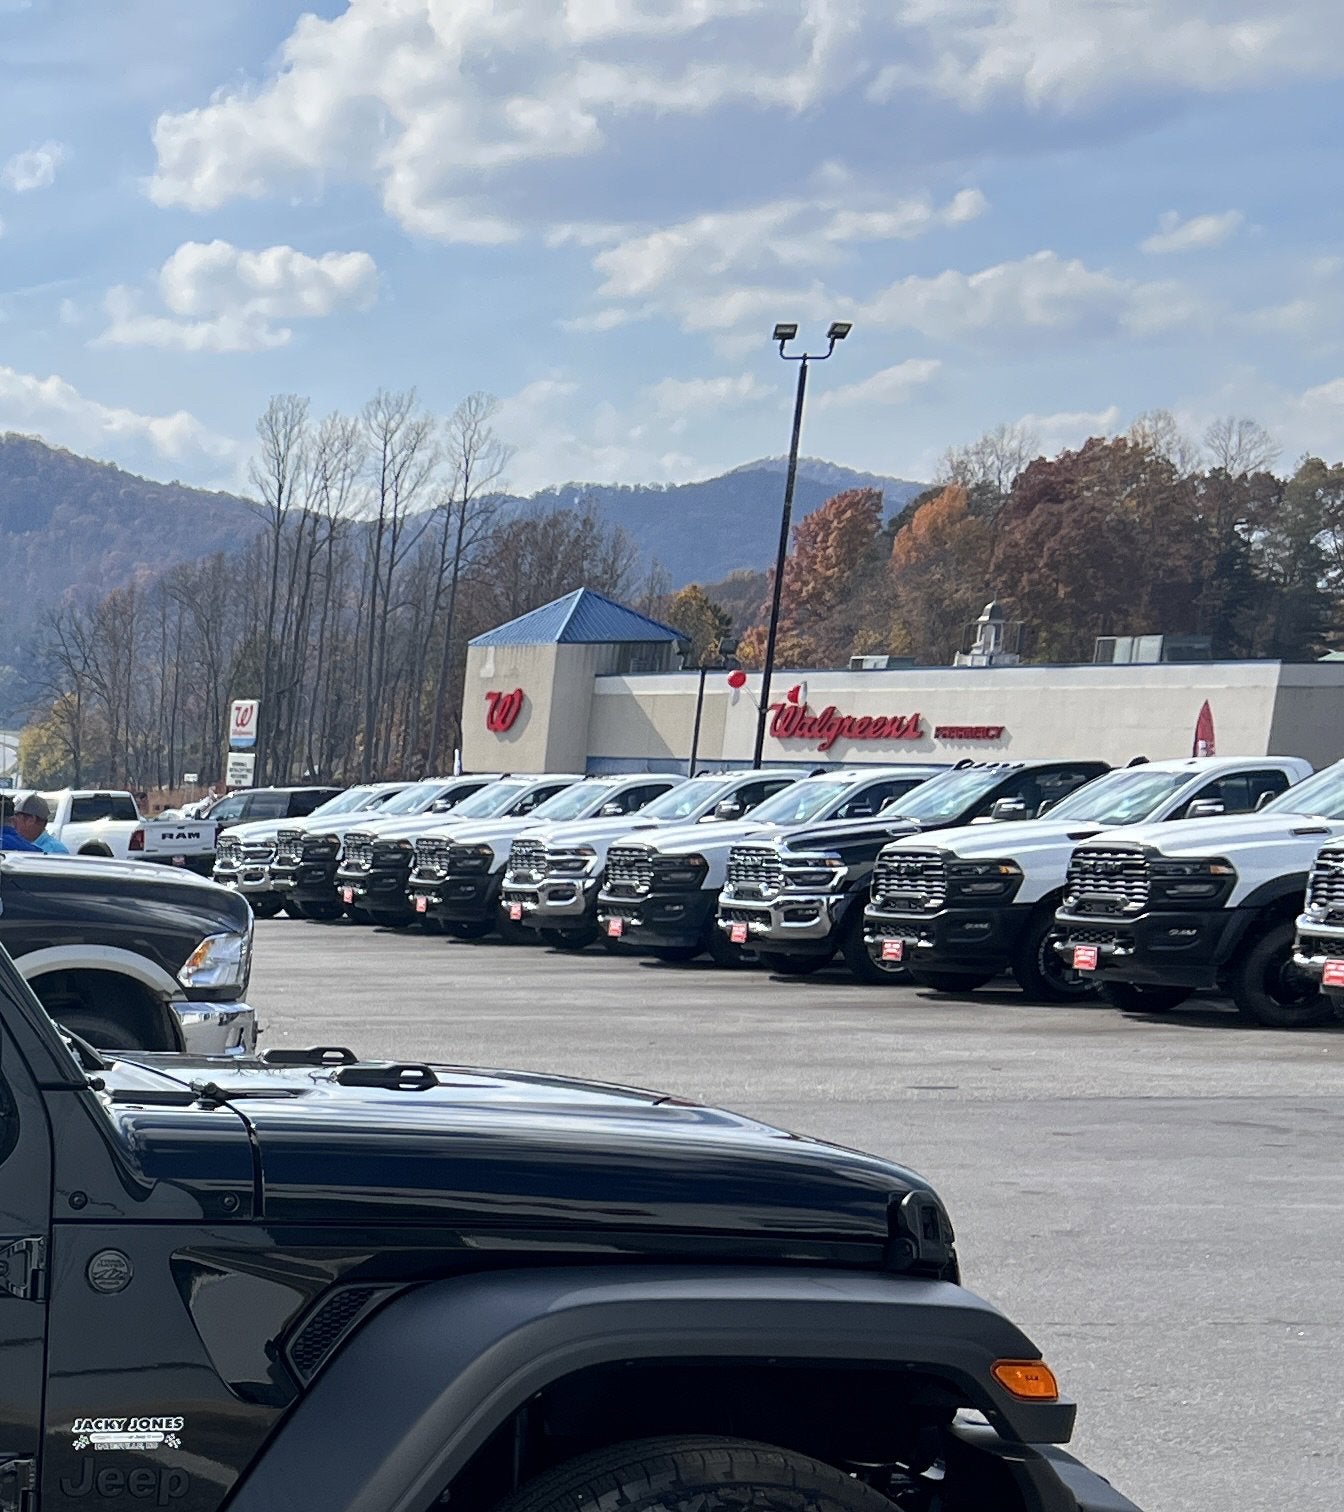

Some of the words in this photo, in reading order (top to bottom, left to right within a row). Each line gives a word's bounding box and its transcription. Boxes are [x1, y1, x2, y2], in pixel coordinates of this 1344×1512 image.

[769, 702, 923, 751] Walgreens
[161, 832, 200, 840] RAM
[72, 1417, 127, 1433] JACKY
[128, 1416, 184, 1431] JONES
[60, 1457, 190, 1505] Jeep
